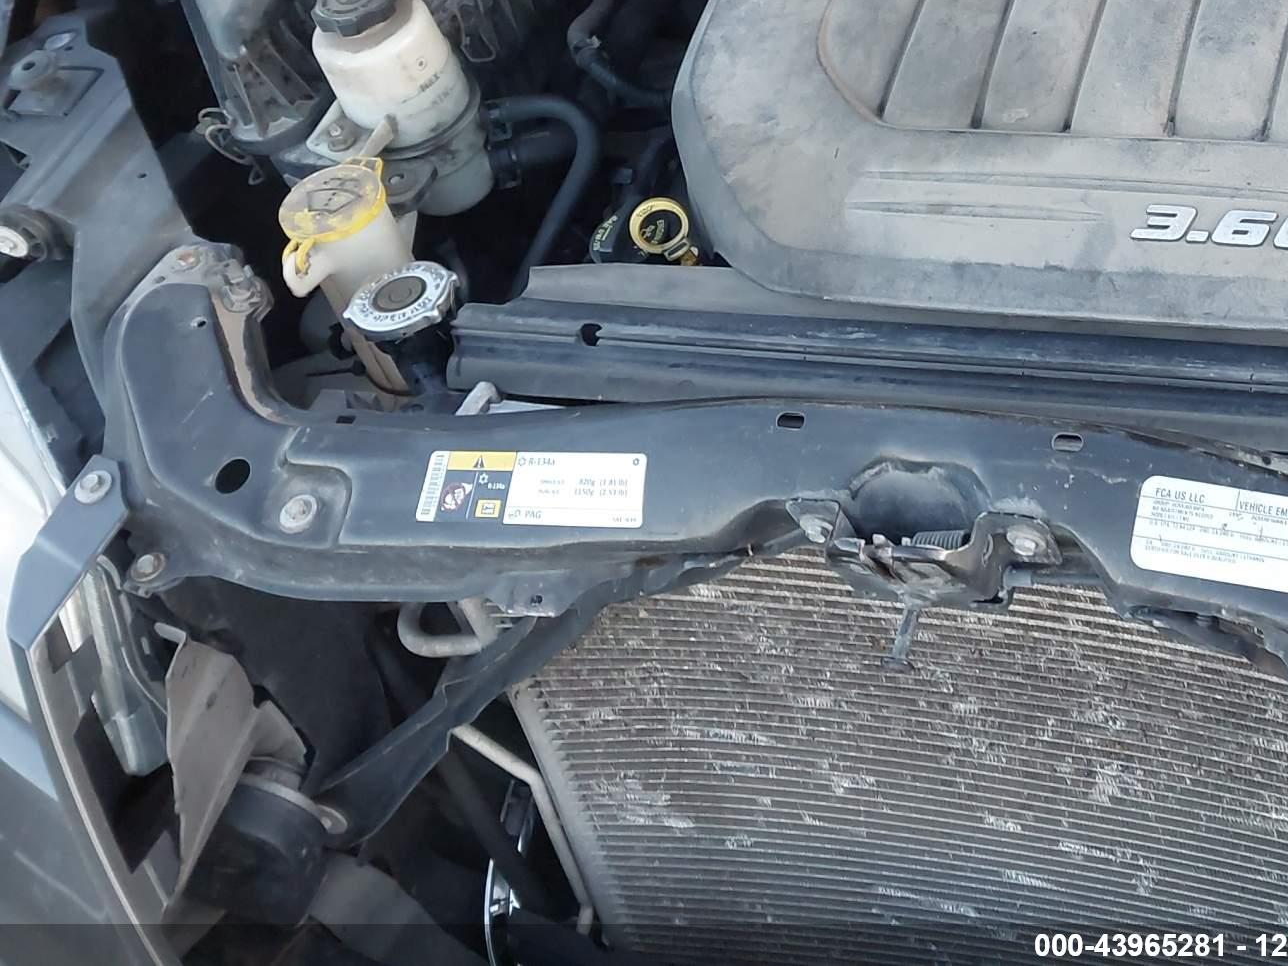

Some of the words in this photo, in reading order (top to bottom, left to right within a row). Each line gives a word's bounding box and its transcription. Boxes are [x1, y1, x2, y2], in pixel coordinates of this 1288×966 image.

[1155, 487, 1171, 499] FCA
[1174, 490, 1187, 502] US
[1189, 492, 1206, 504] LLC
[1239, 500, 1273, 515] VEHICLE
